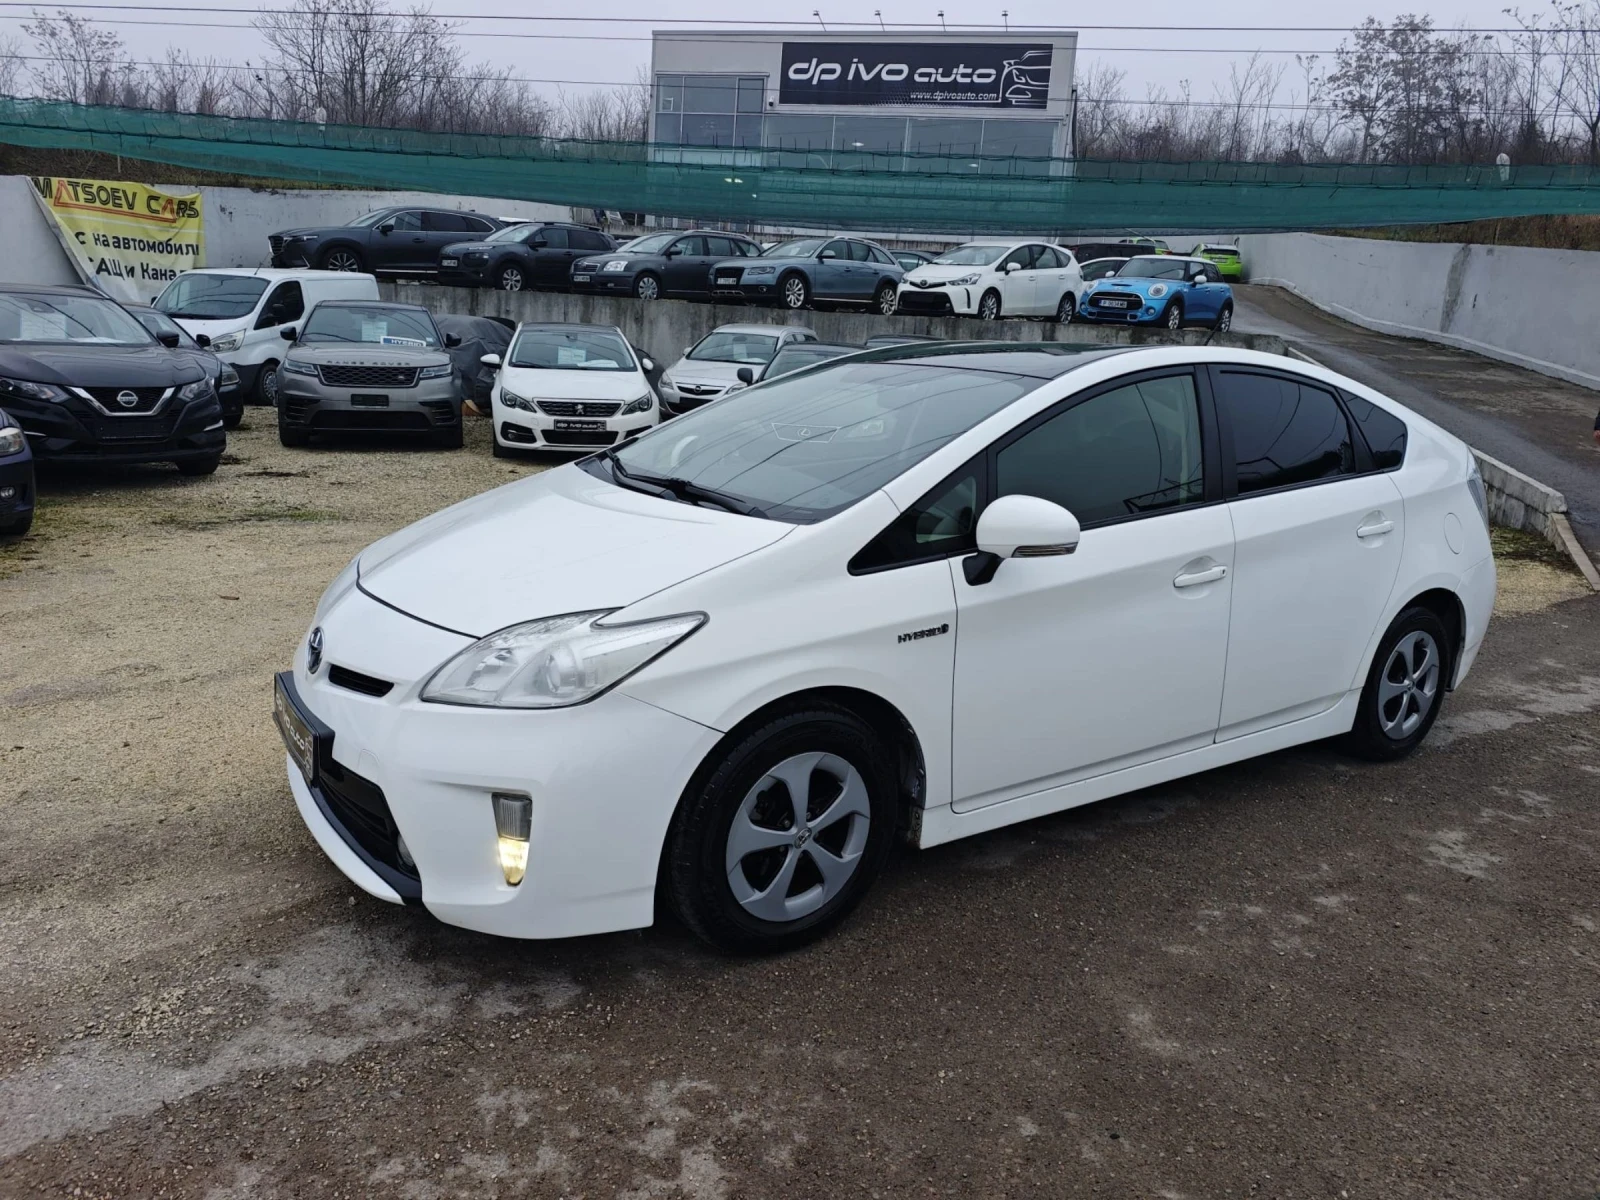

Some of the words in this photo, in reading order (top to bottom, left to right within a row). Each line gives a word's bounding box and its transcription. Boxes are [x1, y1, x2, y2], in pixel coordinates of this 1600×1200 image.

[788, 58, 842, 85] dp
[847, 58, 909, 82] ivo
[914, 64, 997, 83] auto
[910, 91, 997, 101] www.dpivoauto.com
[32, 177, 138, 211] MATSOEV
[146, 195, 200, 219] CARS
[93, 232, 111, 248] на
[897, 627, 942, 644] HYBRID
